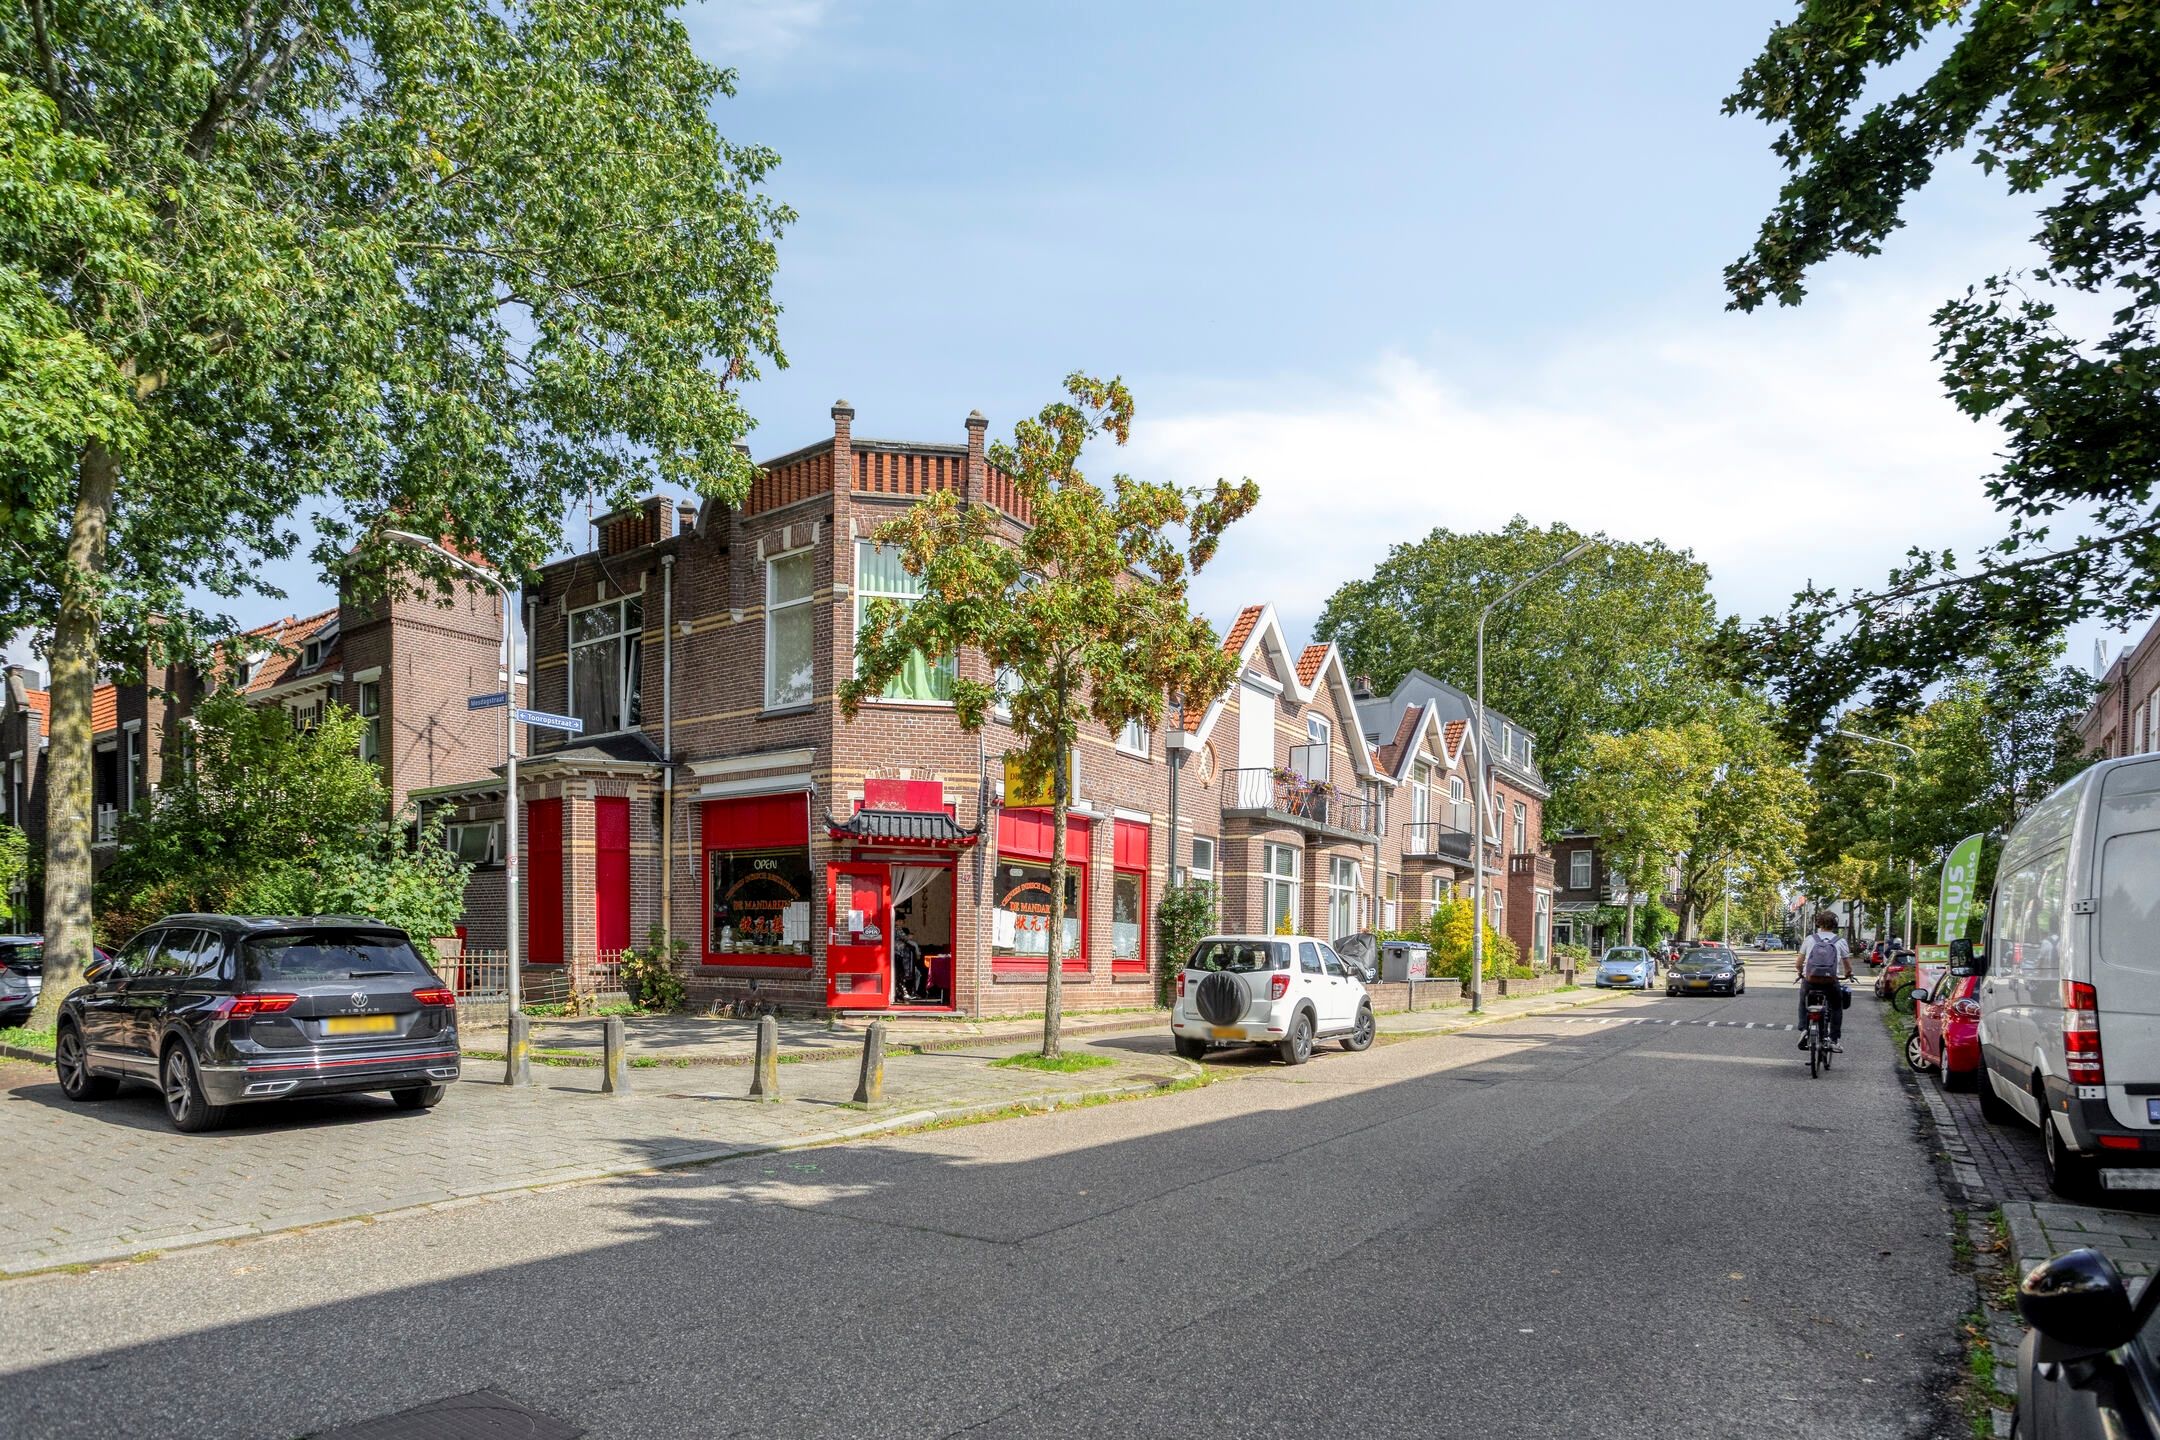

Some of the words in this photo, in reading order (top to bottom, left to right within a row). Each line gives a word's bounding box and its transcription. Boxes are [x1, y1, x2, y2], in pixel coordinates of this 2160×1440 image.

[470, 695, 505, 707] Mesdagstraat
[527, 713, 573, 728] Tooropstraat
[754, 859, 778, 870] OPEN
[1009, 901, 1020, 912] DE
[1021, 902, 1051, 914] MANDAR
[1944, 865, 1965, 942] PLUS
